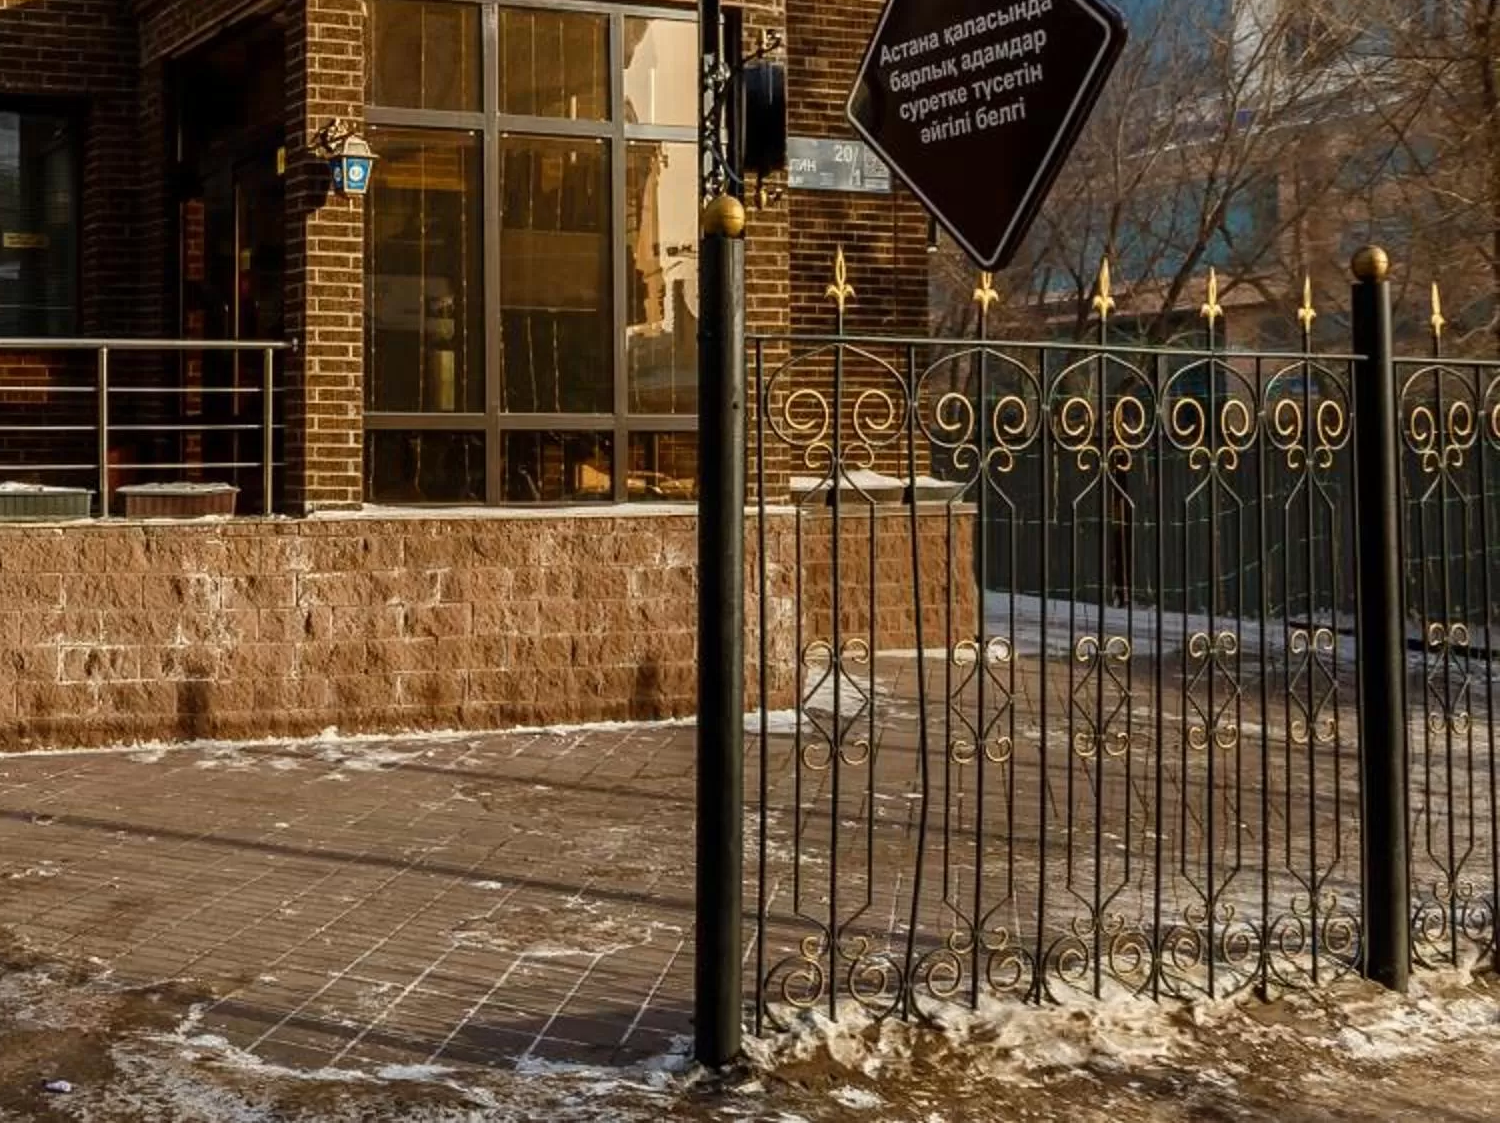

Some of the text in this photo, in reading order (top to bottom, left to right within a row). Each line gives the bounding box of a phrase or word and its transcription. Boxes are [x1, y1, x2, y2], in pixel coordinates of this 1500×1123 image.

[879, 32, 940, 66] Астана
[889, 29, 1048, 92] барлық адамдар
[899, 62, 1044, 123] суретке түсетін
[920, 97, 1027, 145] әйгілі белгі
